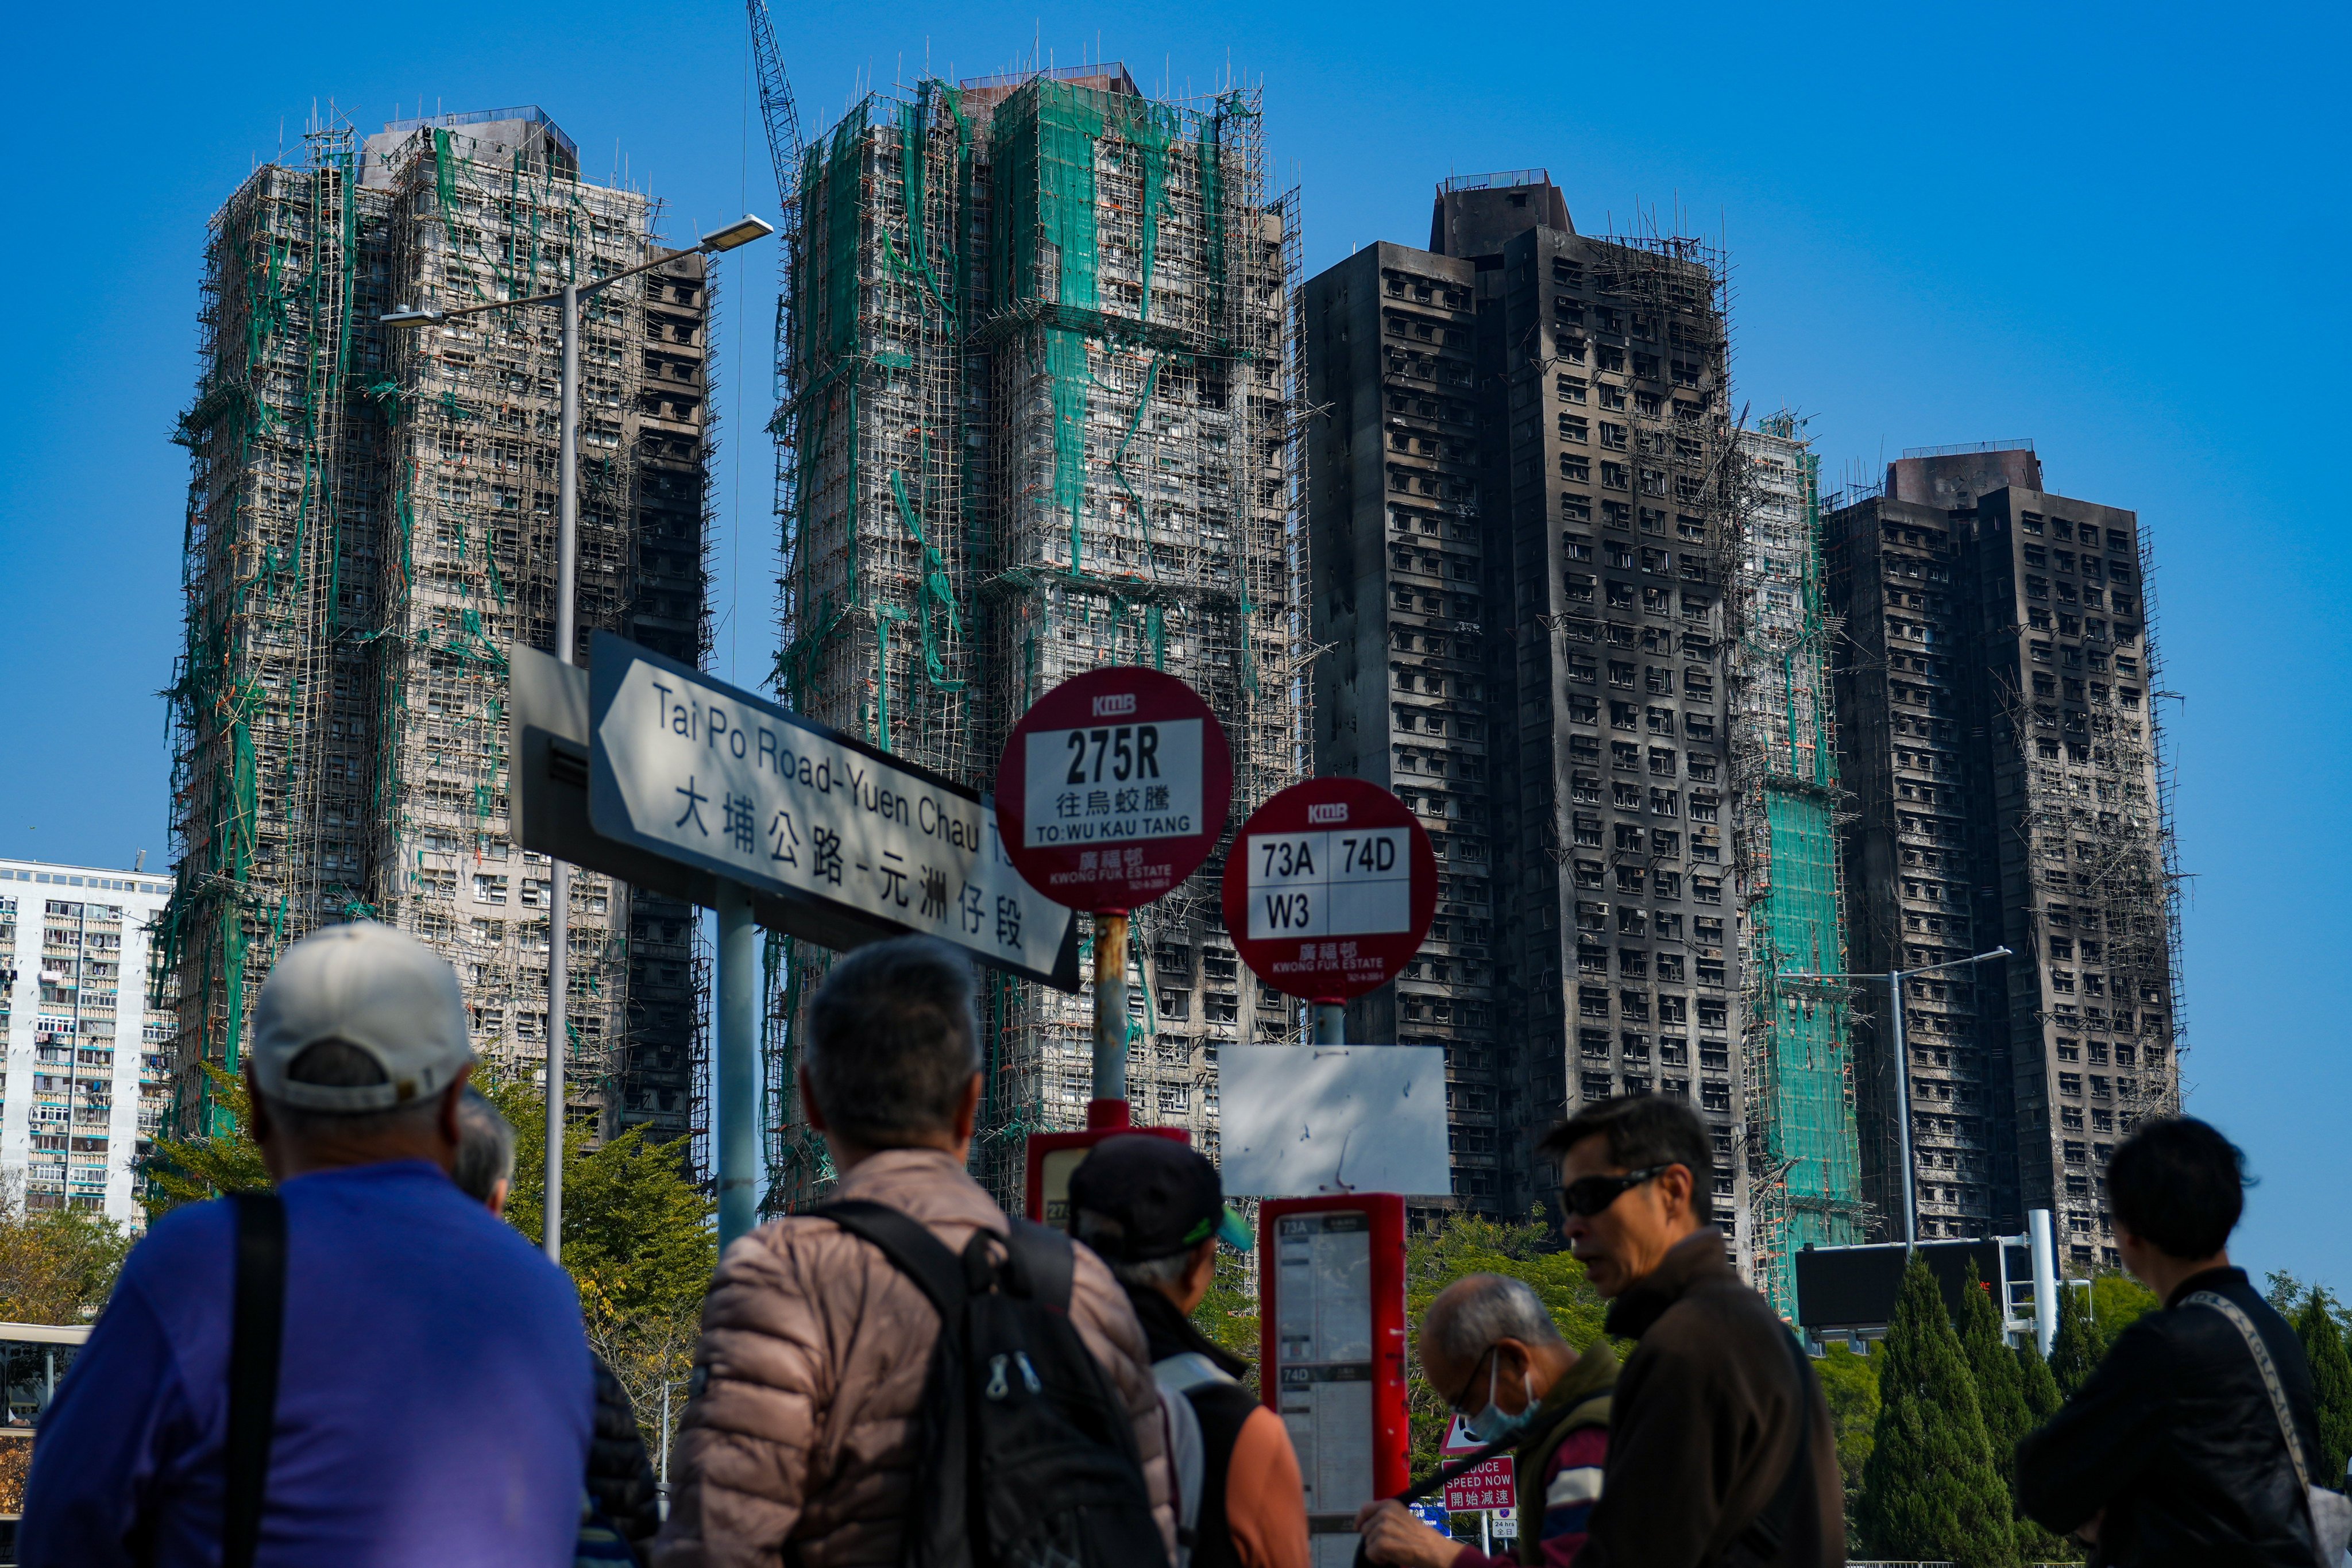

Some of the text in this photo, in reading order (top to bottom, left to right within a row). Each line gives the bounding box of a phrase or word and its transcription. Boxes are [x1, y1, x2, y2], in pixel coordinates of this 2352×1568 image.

[1067, 725, 1160, 785] 275R
[653, 681, 696, 741] Tai
[709, 705, 746, 759] Po
[919, 796, 979, 854] Chau
[1056, 784, 1170, 819] 往烏蛟騰
[1100, 819, 1137, 838] KAU
[1142, 815, 1191, 833] TANG
[1079, 847, 1144, 871] 廣福邨
[1262, 836, 1395, 877] 73A 74D
[1049, 864, 1172, 885] KWONG FUK ESTATE
[1266, 893, 1309, 929] W3
[1299, 941, 1358, 961] 廣福邨
[1272, 957, 1383, 973] KWONG FUK ESTATE
[1283, 1221, 1307, 1233] 73A
[1284, 1368, 1309, 1381] 74D
[1447, 1474, 1511, 1488] SPEED NOW
[1450, 1489, 1509, 1508] 開始減速
